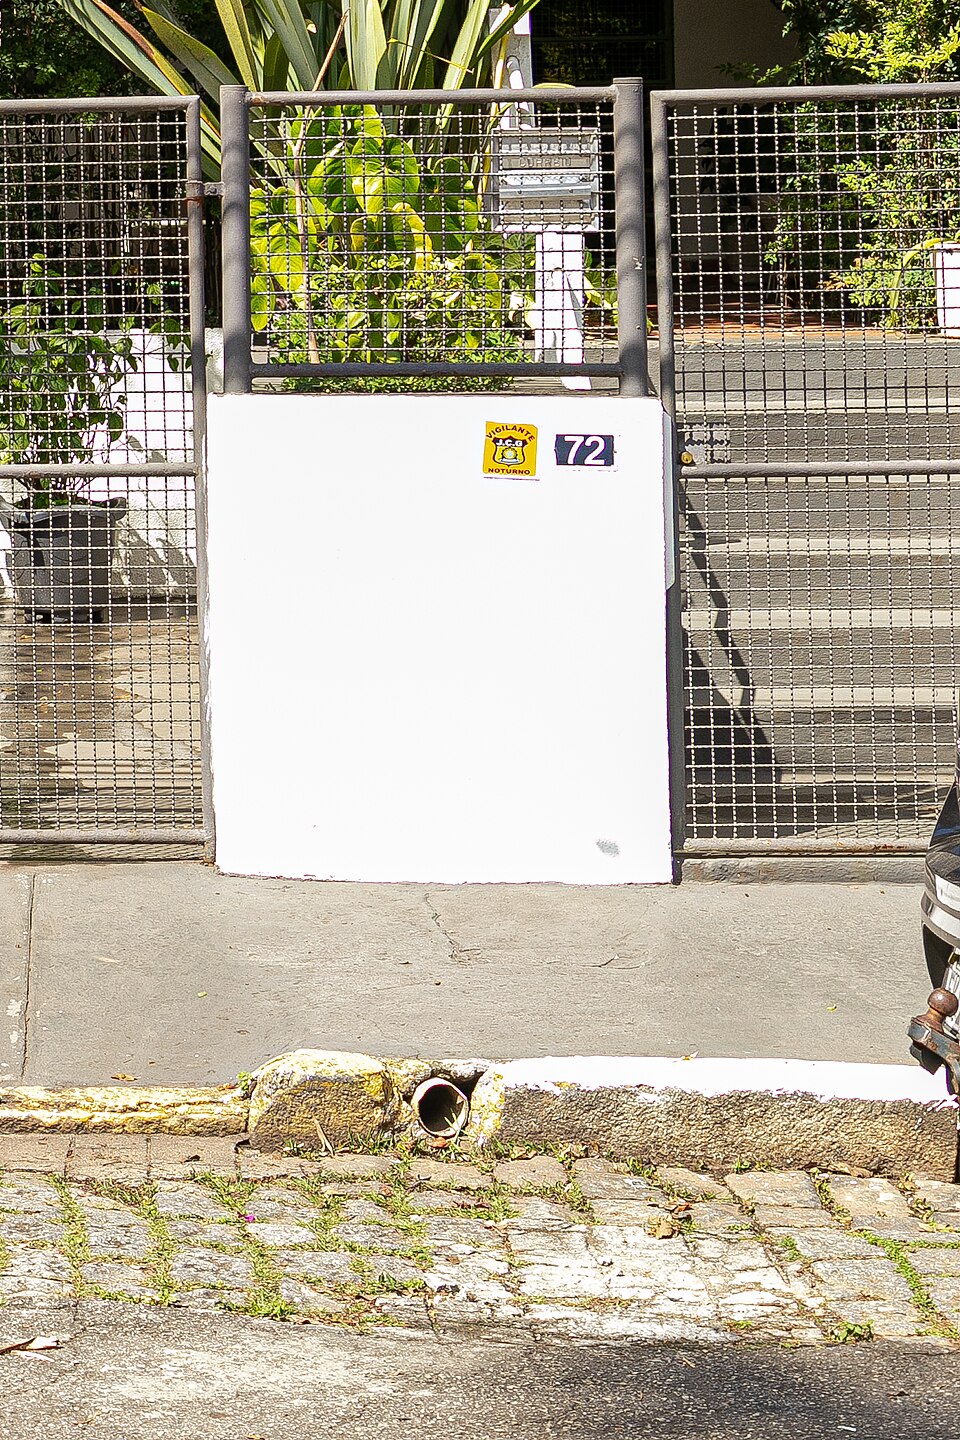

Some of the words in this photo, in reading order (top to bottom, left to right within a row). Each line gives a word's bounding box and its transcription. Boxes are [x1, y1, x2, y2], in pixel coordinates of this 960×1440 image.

[486, 424, 536, 442] VIGILANTE
[563, 435, 607, 465] 72
[487, 467, 531, 475] NOTURNO
